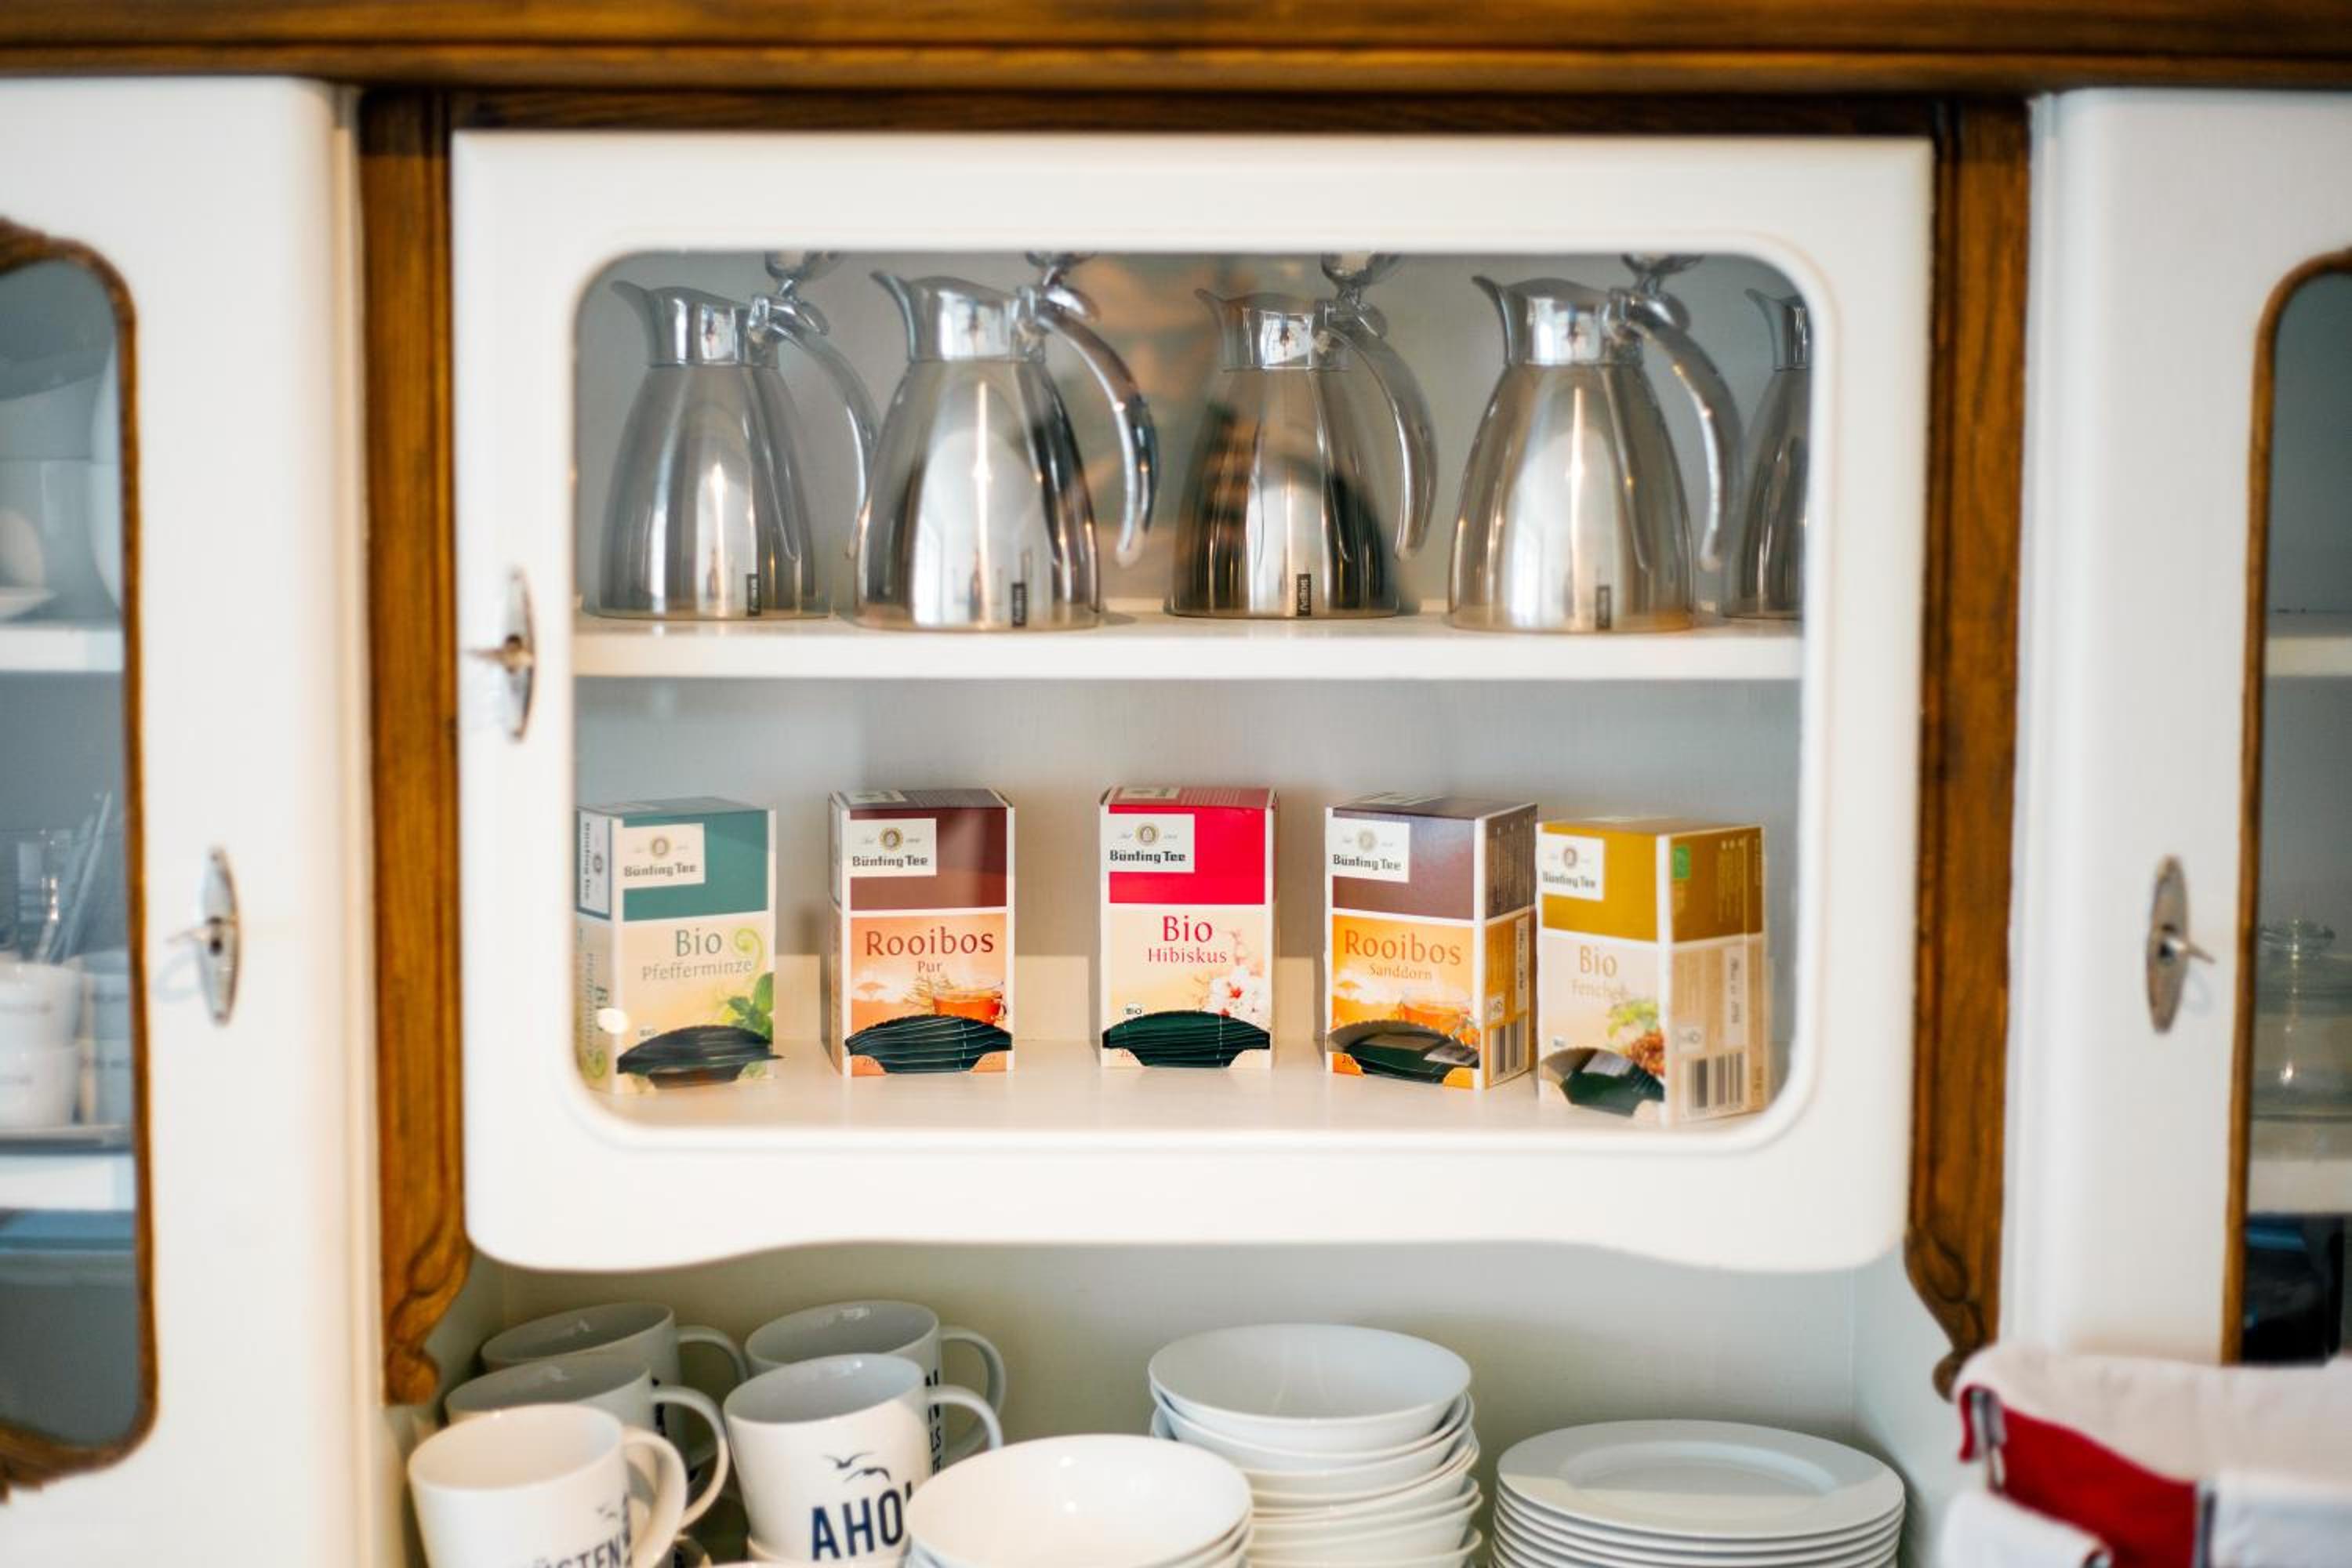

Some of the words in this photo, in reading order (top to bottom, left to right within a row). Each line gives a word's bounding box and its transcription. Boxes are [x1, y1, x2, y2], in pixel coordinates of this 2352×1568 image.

[906, 854, 929, 866] Tee
[1163, 850, 1186, 862] Tee
[1380, 858, 1402, 871] Tee
[1162, 914, 1214, 942] Bio
[675, 927, 723, 957] Bio
[865, 926, 995, 957] Rooibos
[1344, 928, 1462, 966] Rooibos
[1148, 947, 1228, 964] Hibiskus
[1579, 943, 1618, 978] Bio
[641, 960, 753, 982] Pfefferminze
[917, 960, 943, 974] Pur
[1369, 964, 1432, 981] Sanddorn
